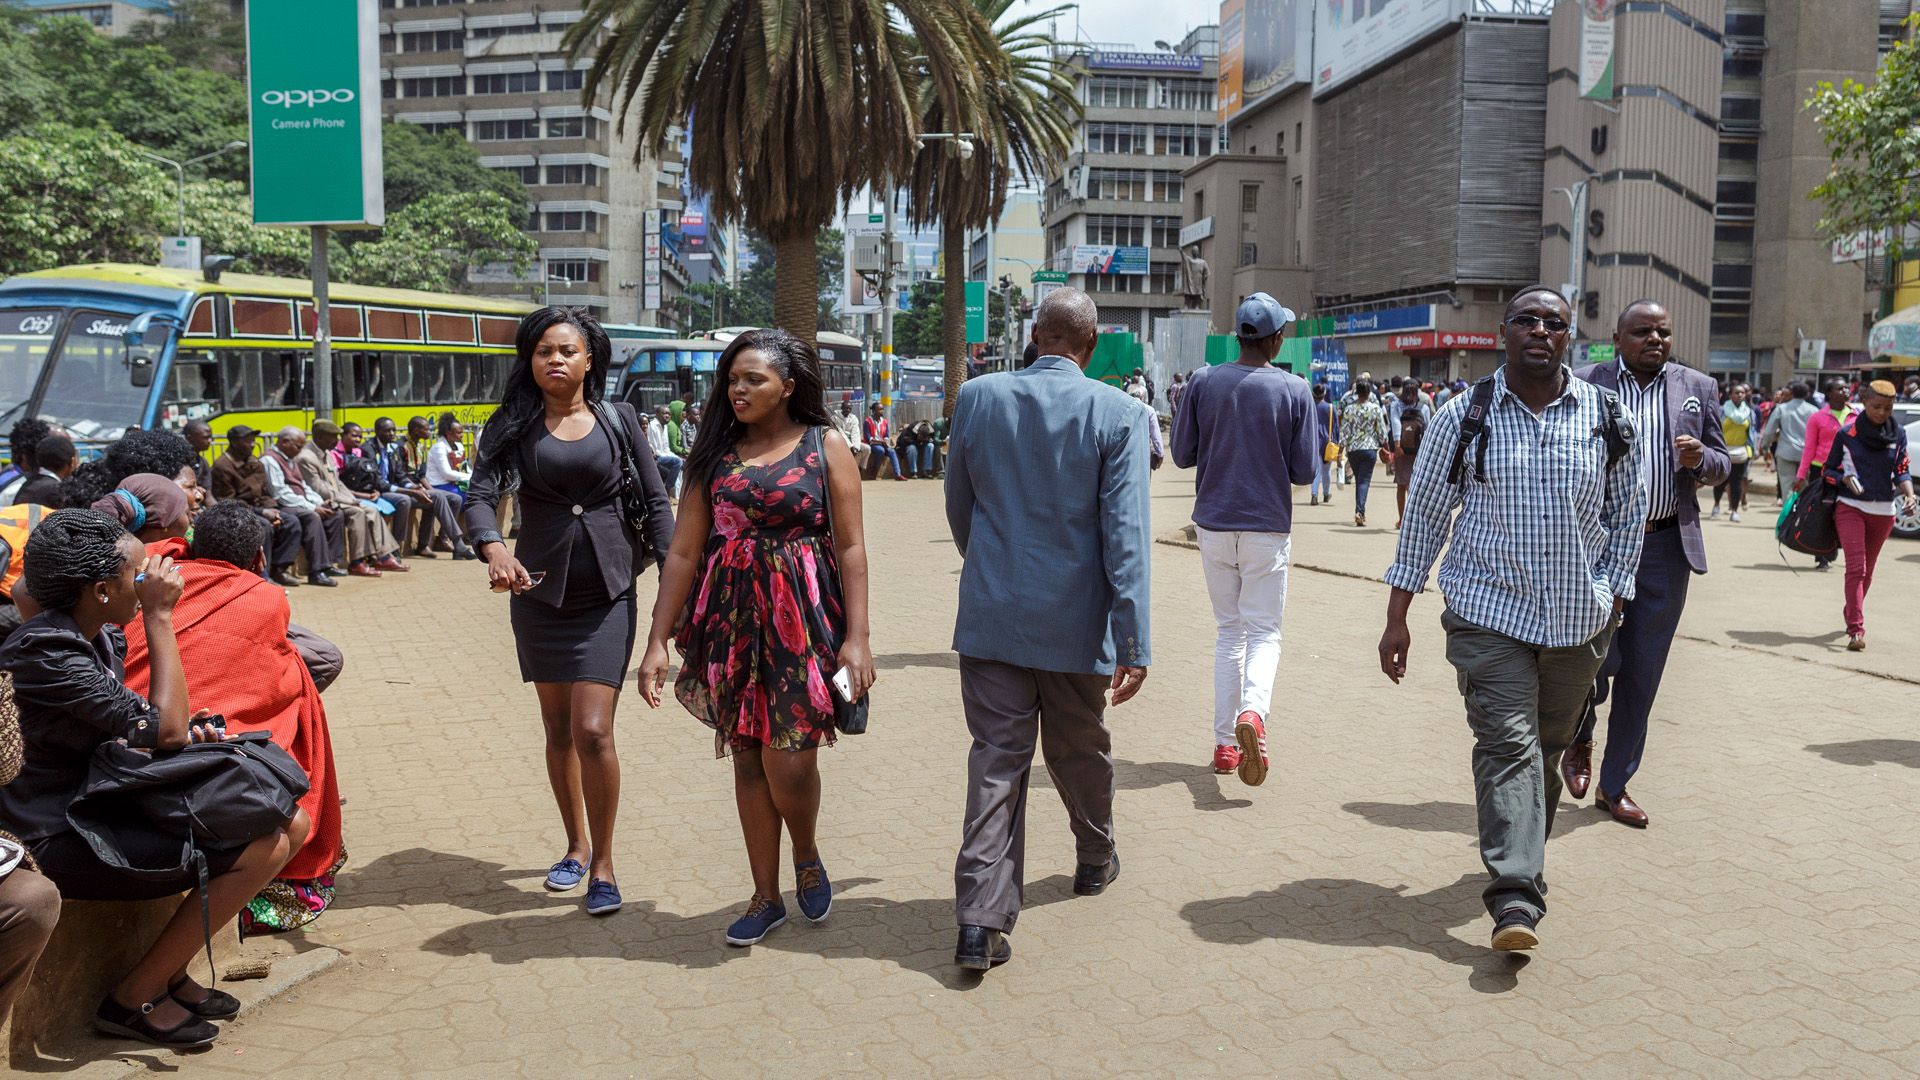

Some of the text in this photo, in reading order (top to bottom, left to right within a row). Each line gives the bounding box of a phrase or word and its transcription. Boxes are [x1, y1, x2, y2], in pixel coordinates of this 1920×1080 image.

[271, 117, 346, 130] Camera Phone
[19, 315, 54, 334] City
[1333, 317, 1373, 331] Standard Chartered
[1457, 335, 1494, 346] Mr Price
